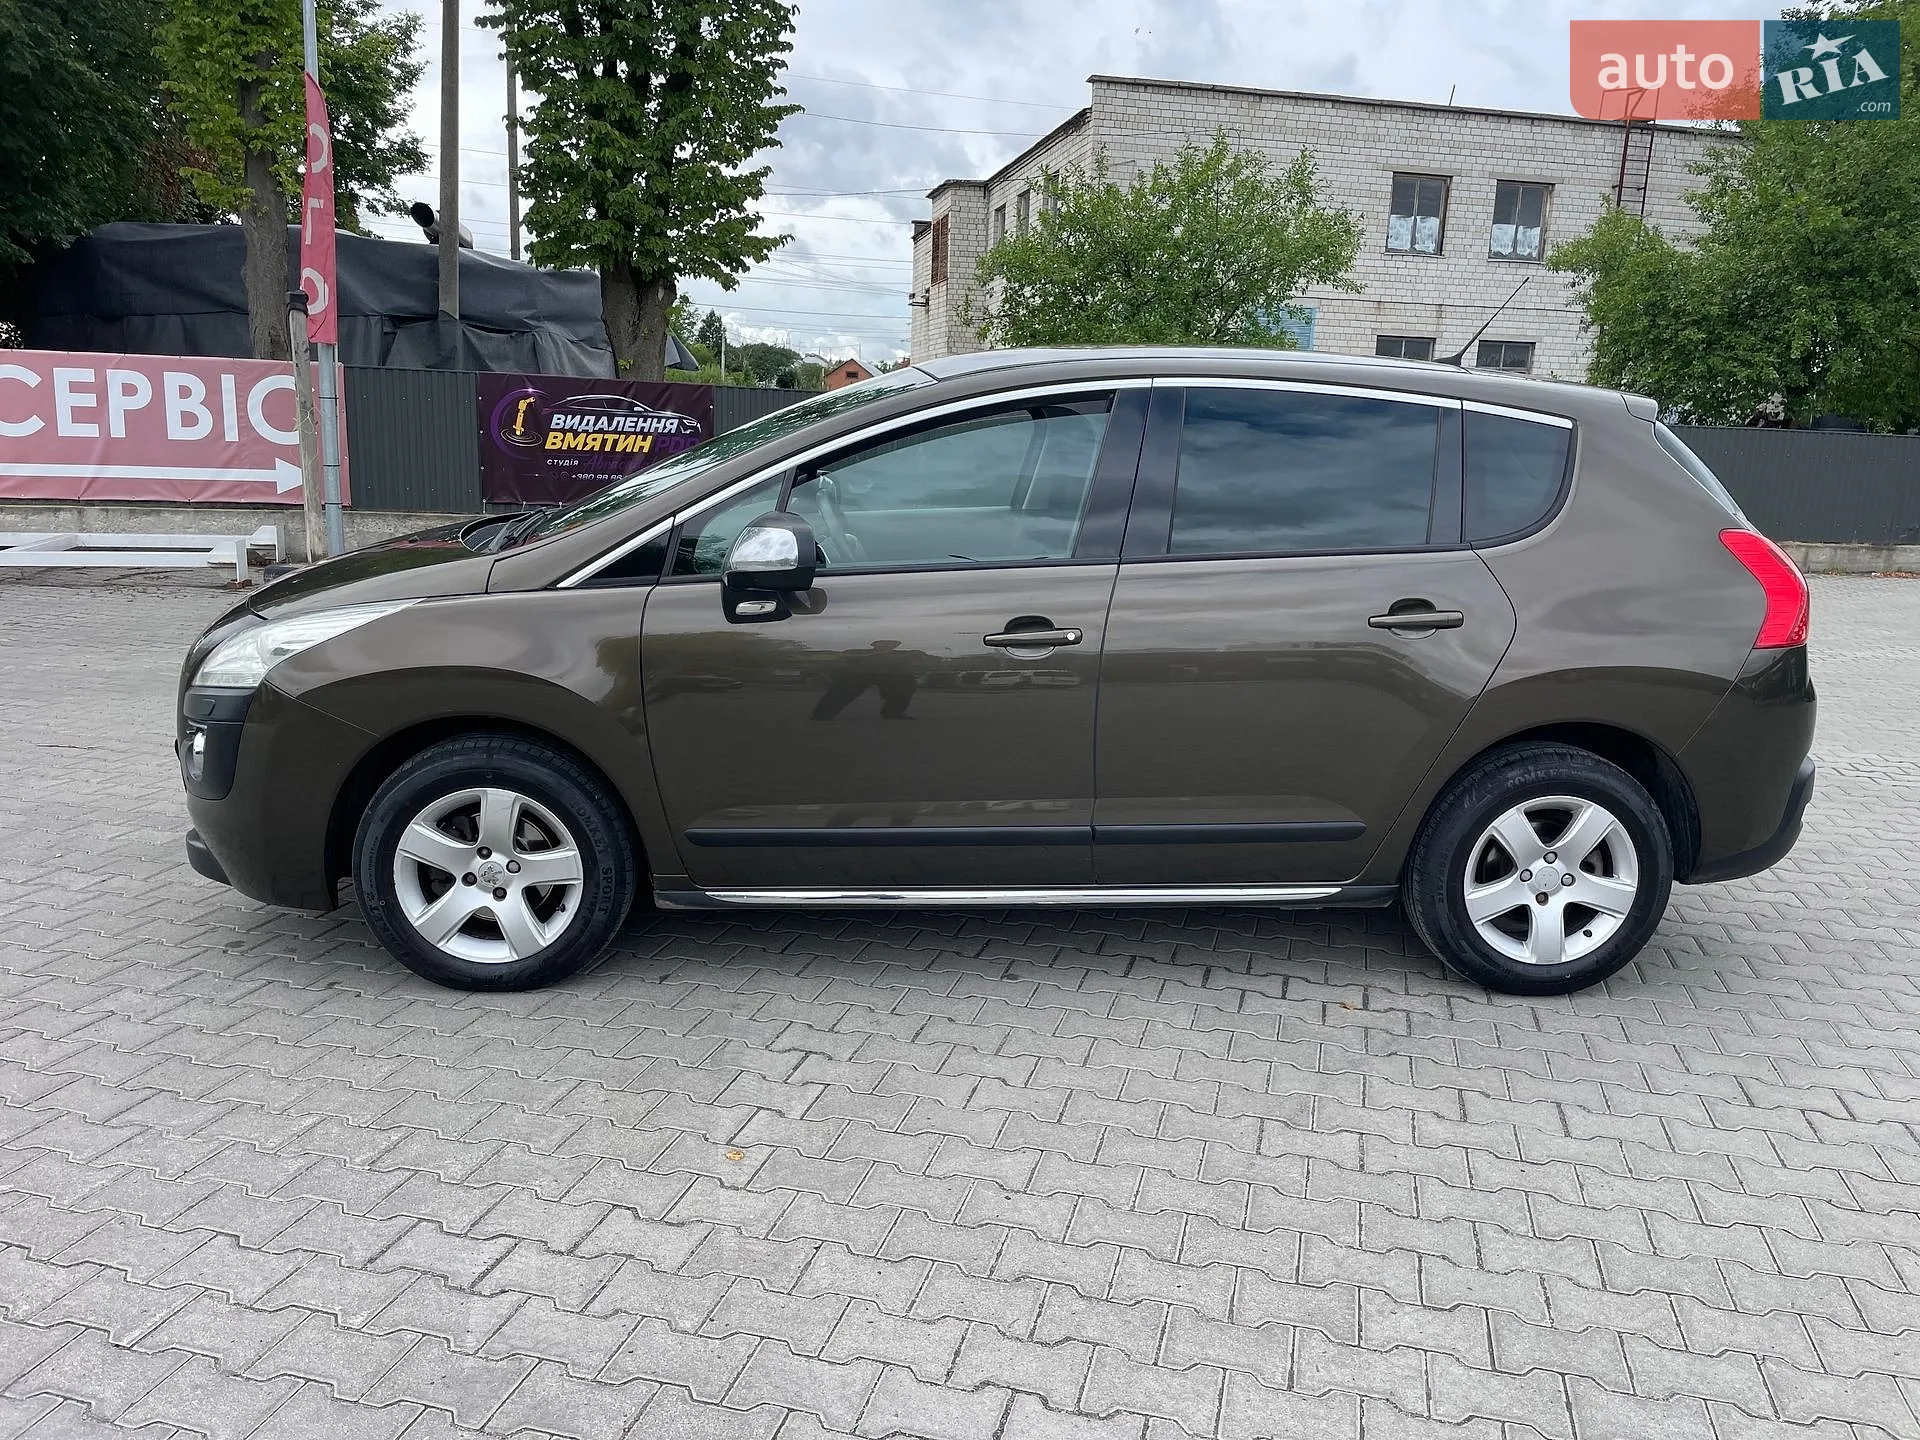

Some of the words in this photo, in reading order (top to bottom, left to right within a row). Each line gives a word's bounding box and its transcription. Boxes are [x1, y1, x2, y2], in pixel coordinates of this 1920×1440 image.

[550, 413, 680, 434] ВИДАЛЕННЯ
[544, 431, 653, 453] ВМЯТИН
[547, 457, 579, 467] студія
